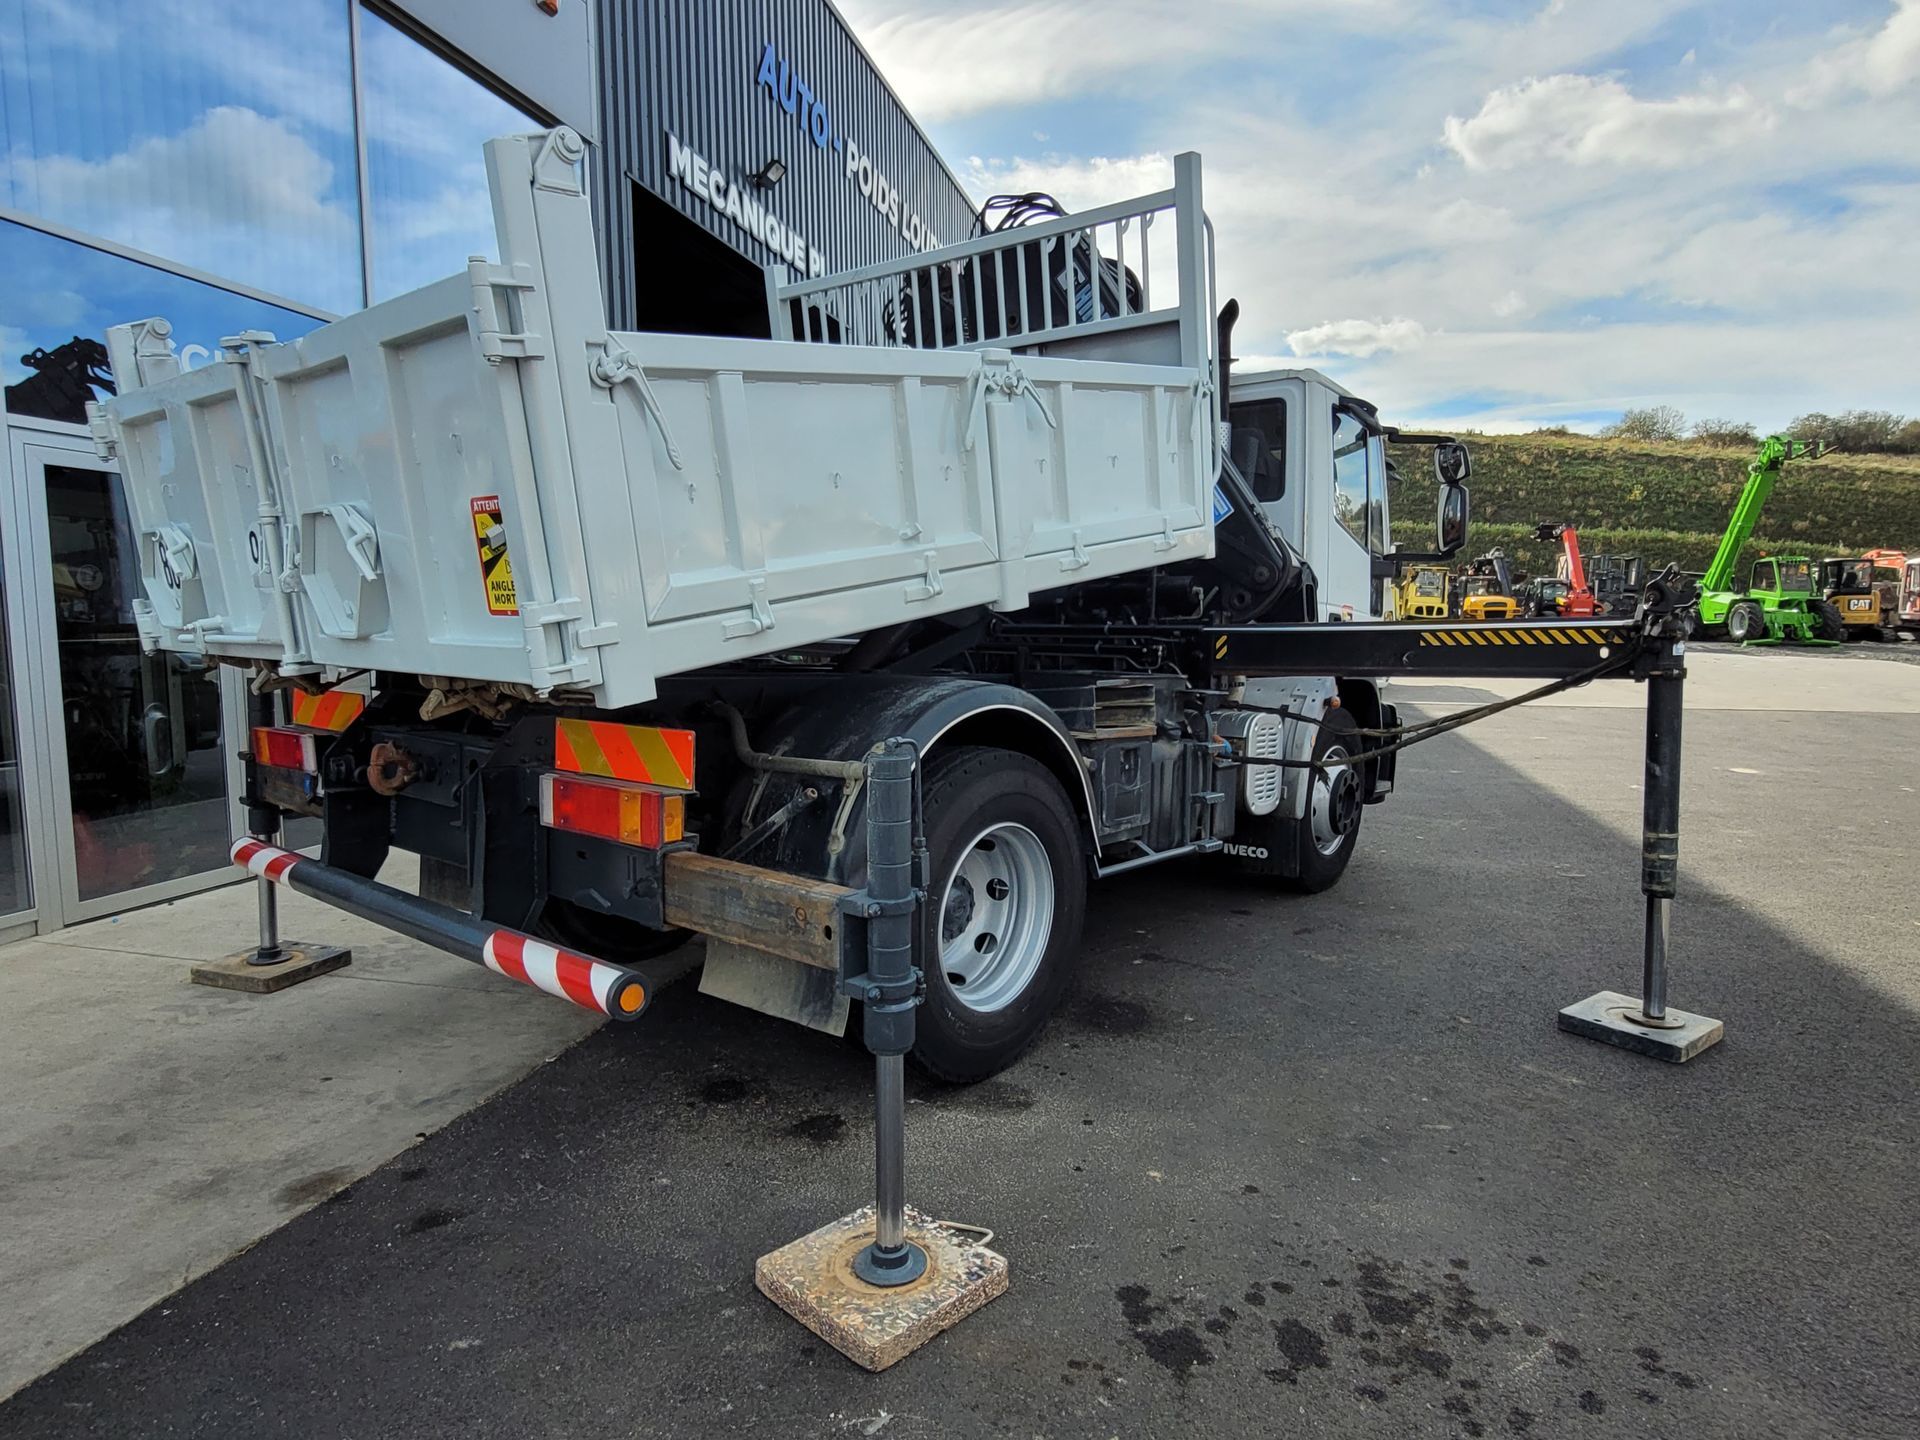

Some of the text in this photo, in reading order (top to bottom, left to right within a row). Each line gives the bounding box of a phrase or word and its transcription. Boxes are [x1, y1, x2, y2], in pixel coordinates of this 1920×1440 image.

[757, 43, 829, 148] AUTO
[846, 137, 899, 227] POIDS
[668, 133, 806, 274] MECANIQUE
[491, 580, 516, 592] ANGLE
[494, 593, 517, 605] MORT
[1849, 599, 1871, 610] CAT
[1223, 842, 1269, 859] IVECO
